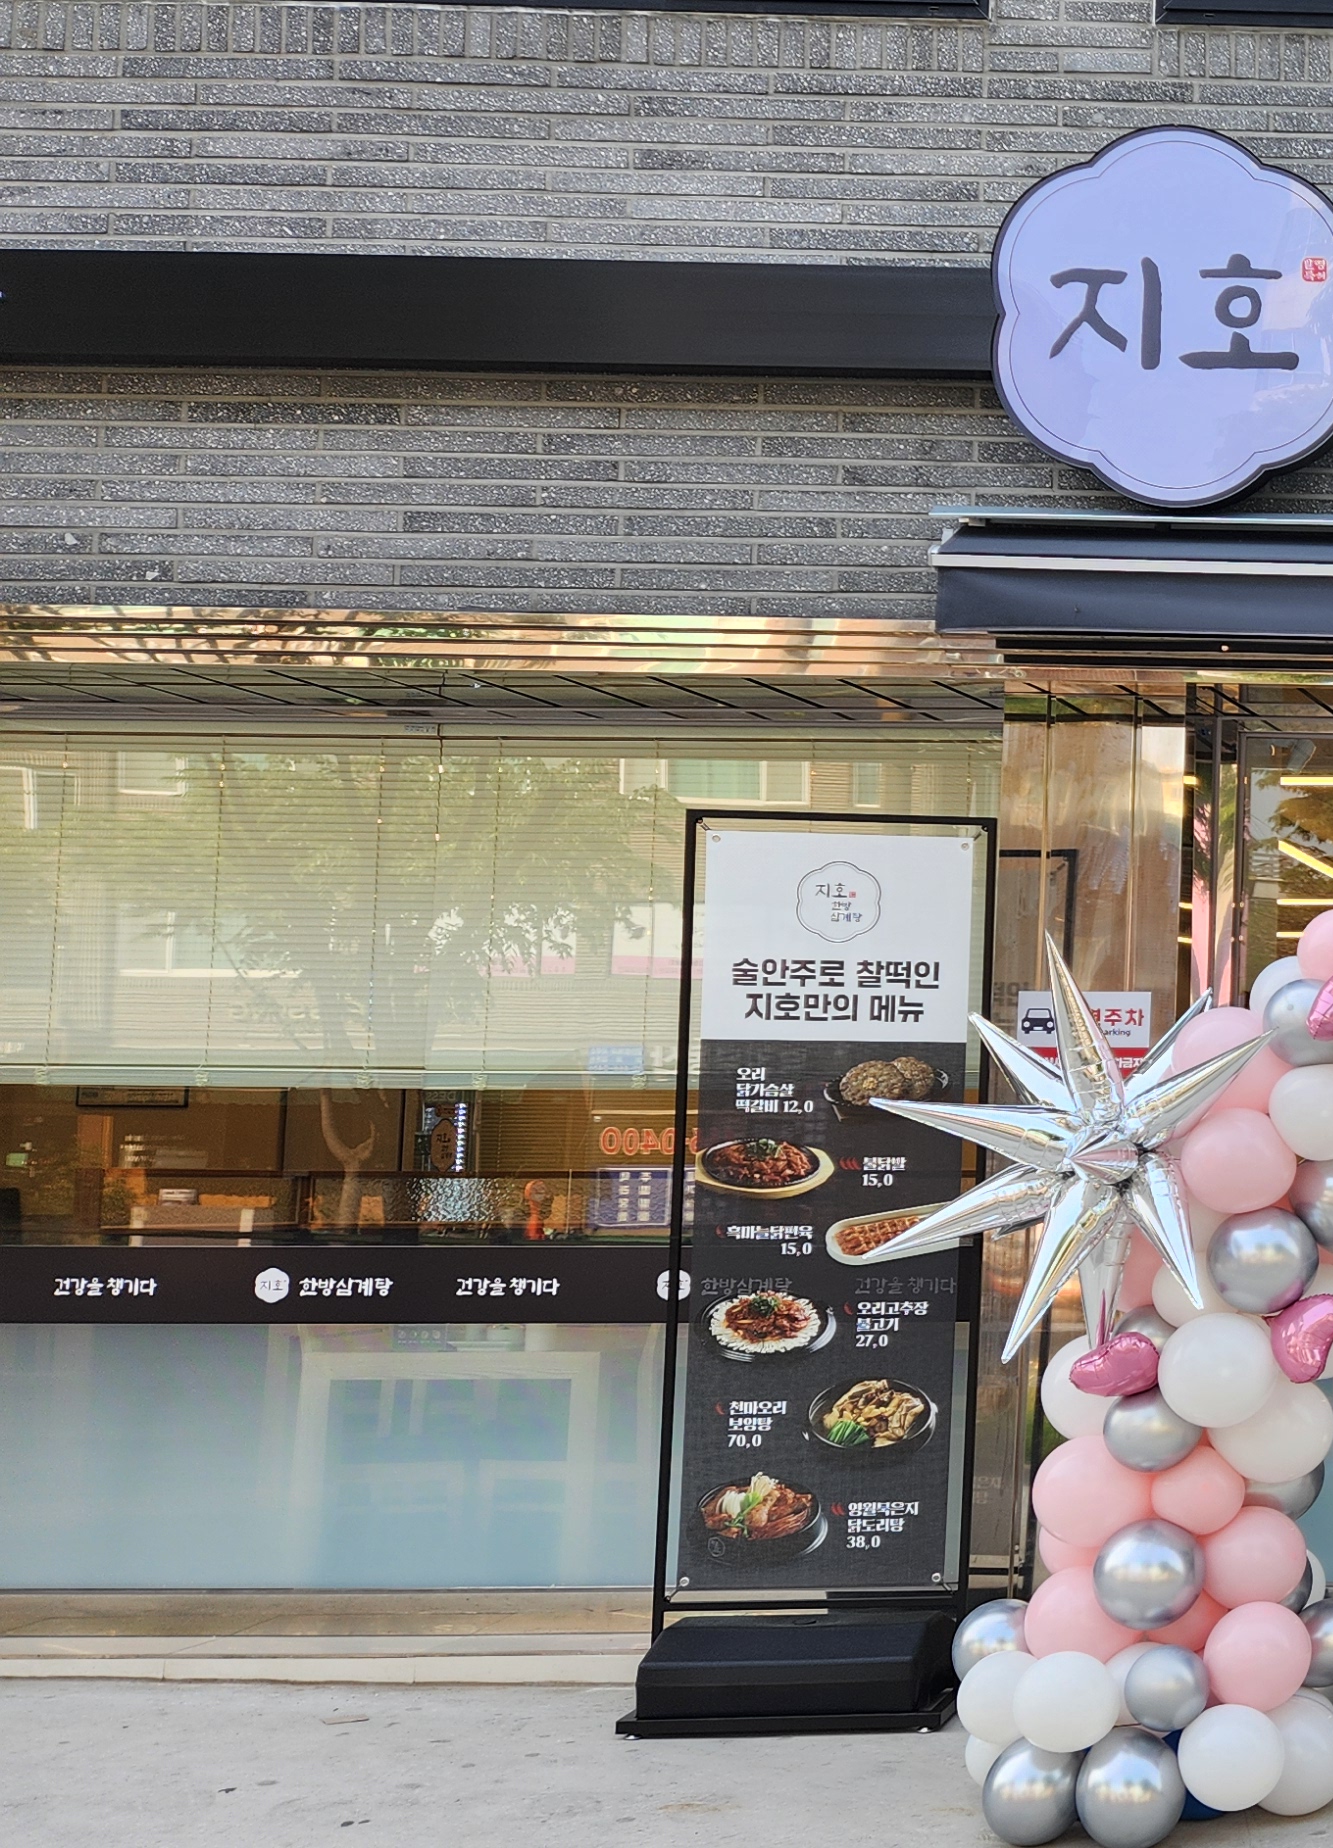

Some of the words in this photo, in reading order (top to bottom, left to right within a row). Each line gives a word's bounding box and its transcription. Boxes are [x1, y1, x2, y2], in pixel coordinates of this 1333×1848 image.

[1050, 254, 1299, 370] 지호
[815, 883, 847, 898] 지호
[832, 901, 851, 911] 한방
[830, 912, 862, 923] 삼계탕
[732, 958, 845, 987] 술안주로
[856, 960, 939, 989] 찰떡인
[745, 993, 858, 1021] 지호만의
[869, 994, 924, 1022] 메뉴
[736, 1067, 766, 1081] 오리
[736, 1083, 795, 1098] 닭가슴살
[735, 1099, 779, 1114] 떡갈비
[783, 1100, 814, 1115] 12,0
[861, 1173, 893, 1187] 15,0
[726, 1225, 813, 1240] 흑마늘닭편육
[780, 1242, 812, 1256] 15,0
[54, 1277, 102, 1296] 건강을
[106, 1276, 157, 1296] 챙기다
[299, 1277, 393, 1296] 한방삼계탕
[456, 1277, 505, 1296] 건강을
[509, 1276, 560, 1296] 챙기다
[857, 1301, 928, 1316] 오리고추장
[856, 1317, 899, 1332] 불고기
[856, 1334, 888, 1349] 27,0
[728, 1400, 787, 1415] 천마오리
[727, 1433, 762, 1448] 70,0
[847, 1518, 905, 1534] 닭도리탕
[846, 1535, 881, 1550] 38,0
